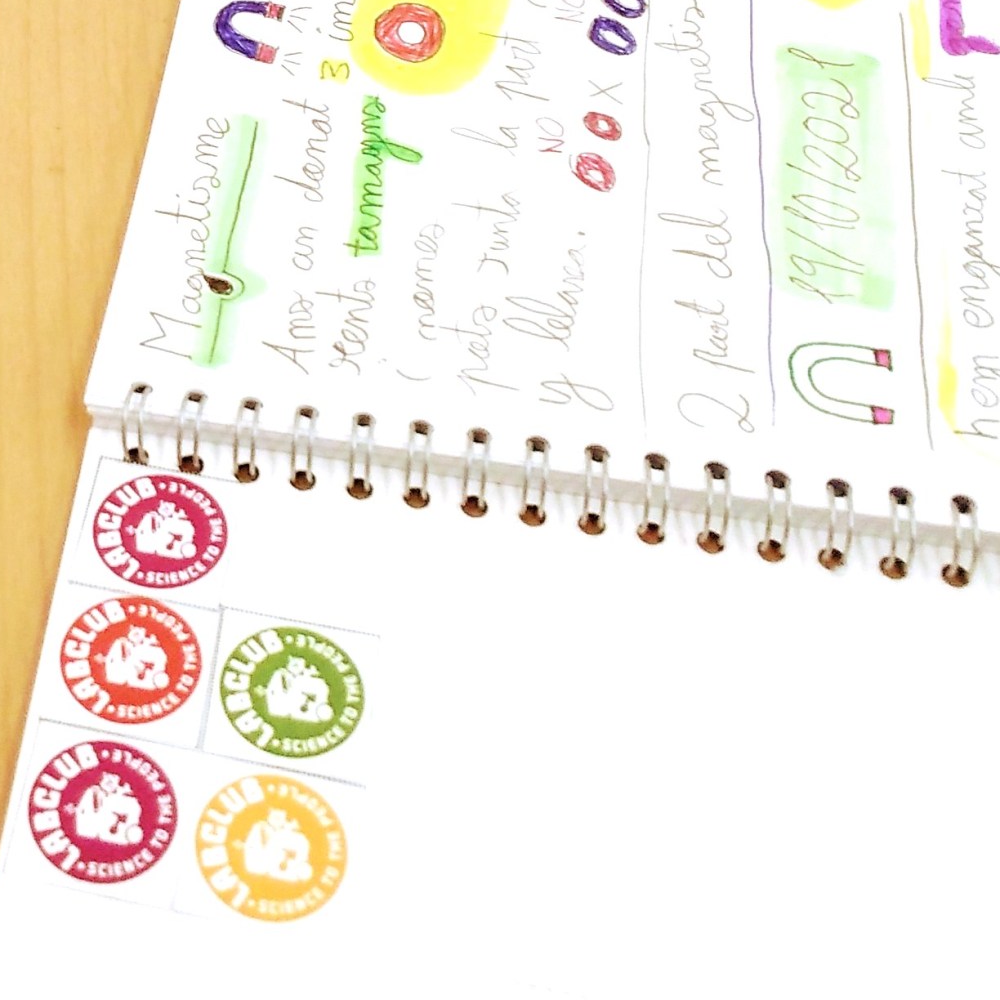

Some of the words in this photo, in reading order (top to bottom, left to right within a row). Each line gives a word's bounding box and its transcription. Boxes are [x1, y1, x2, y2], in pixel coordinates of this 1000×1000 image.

[320, 60, 351, 80] 3
[479, 32, 549, 101] part
[450, 126, 520, 156] la
[536, 117, 564, 153] NO
[784, 47, 865, 304] 19/10/2021
[139, 117, 234, 361] Magnetisme
[658, 210, 732, 278] del
[674, 300, 755, 373] part
[539, 374, 614, 411] y
[677, 393, 754, 433] 2
[168, 481, 217, 516] PEOPLE
[97, 477, 157, 580] LABCLUB
[209, 518, 222, 542] THE
[202, 545, 220, 561] TO
[145, 560, 206, 584] SCIENCE
[138, 604, 191, 641] PEOPLE
[64, 600, 127, 713] LABCLUB
[182, 643, 197, 670] THE
[296, 633, 350, 673] PEOPLE
[175, 674, 194, 692] TO
[223, 630, 284, 748] LABCLUB
[343, 674, 360, 703] THE
[117, 692, 181, 719] SCIENCE
[339, 706, 358, 725] TO
[282, 724, 346, 752] SCIENCE
[112, 748, 166, 792] PEOPLE
[33, 743, 99, 871] LABCLUB
[157, 794, 172, 824] THE
[150, 828, 169, 848] TO
[200, 776, 265, 908] LABCLUB
[87, 848, 155, 876] SCIENCE
